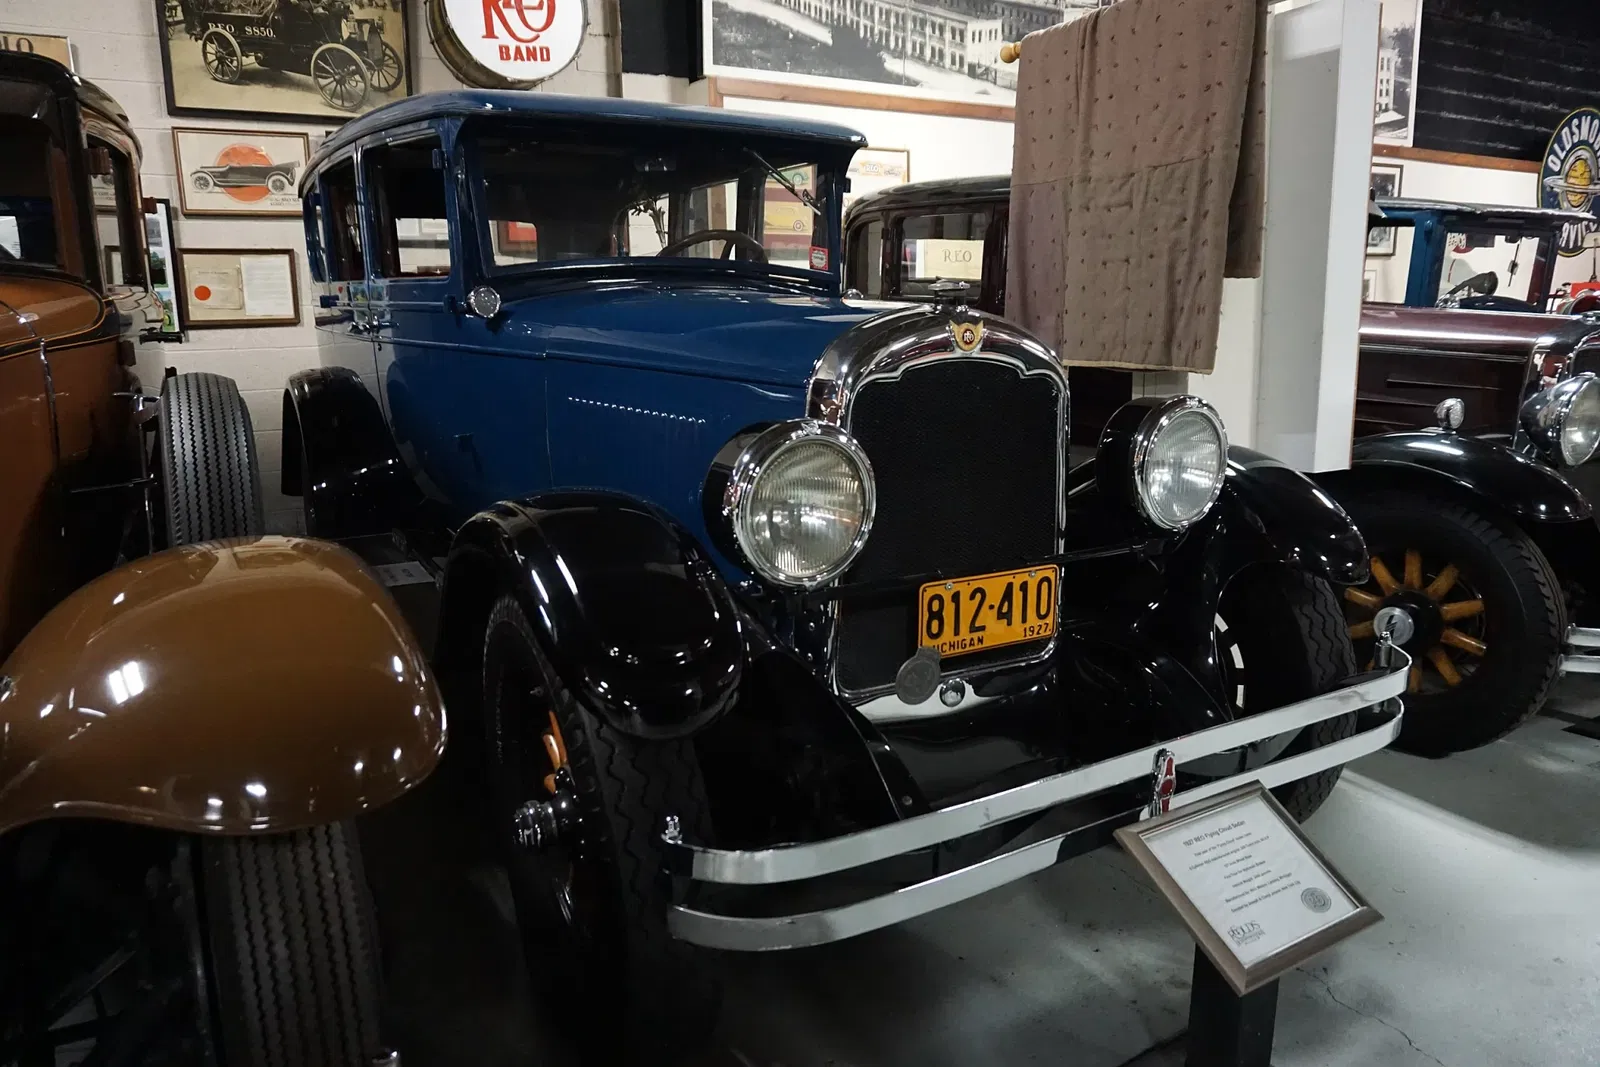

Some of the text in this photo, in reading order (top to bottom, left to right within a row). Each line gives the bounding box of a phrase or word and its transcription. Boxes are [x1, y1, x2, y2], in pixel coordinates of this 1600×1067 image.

[499, 44, 551, 62] BAND
[942, 248, 972, 263] REO
[1023, 622, 1050, 638] 1927
[1203, 829, 1220, 839] Flying
[1217, 824, 1233, 833] Cloud
